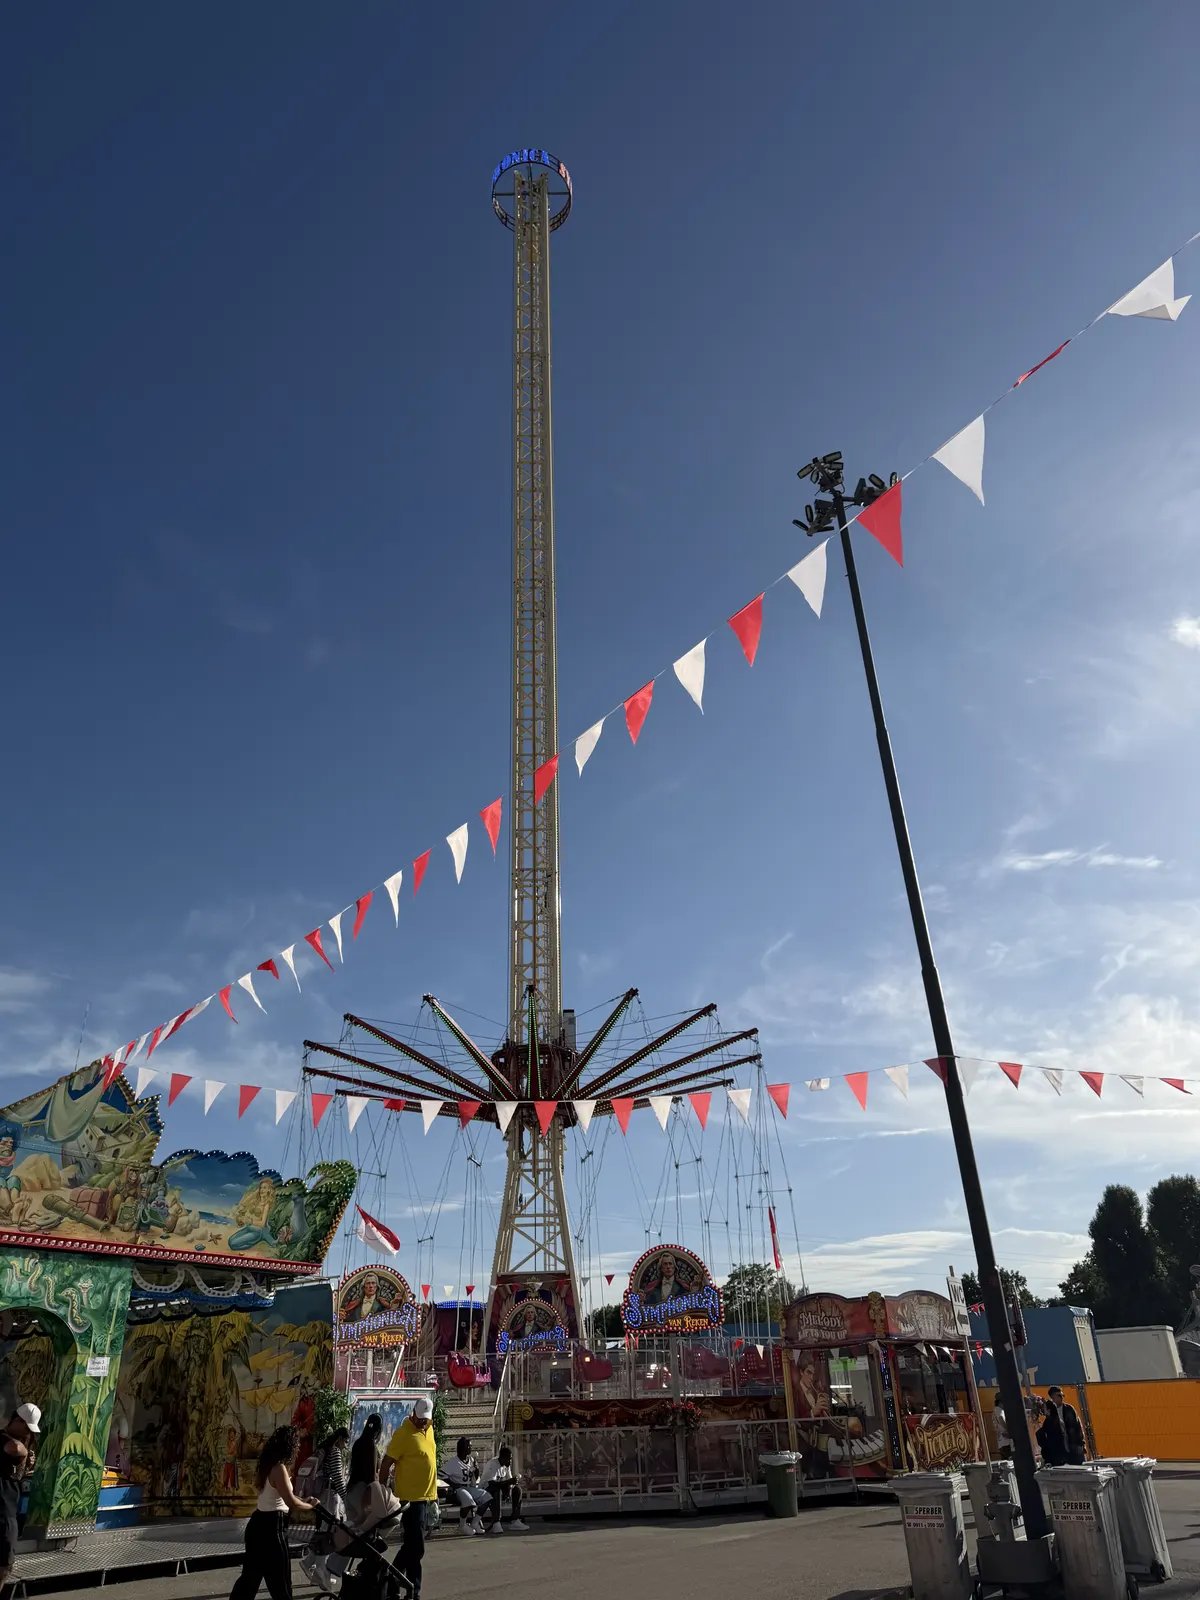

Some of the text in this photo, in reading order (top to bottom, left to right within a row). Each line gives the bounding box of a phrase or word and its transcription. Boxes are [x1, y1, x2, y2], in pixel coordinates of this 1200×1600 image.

[950, 1284, 965, 1304] WC
[625, 1286, 719, 1327] SYMPHONICA
[668, 1316, 709, 1328] VAN REKEN
[799, 1311, 842, 1329] MELODY
[364, 1332, 404, 1344] VAN REKEN
[820, 1329, 836, 1340] YOU
[837, 1329, 848, 1340] UP
[915, 1420, 968, 1464] TICKETS
[914, 1506, 943, 1515] SPERBER
[1062, 1501, 1091, 1510] SPERBER
